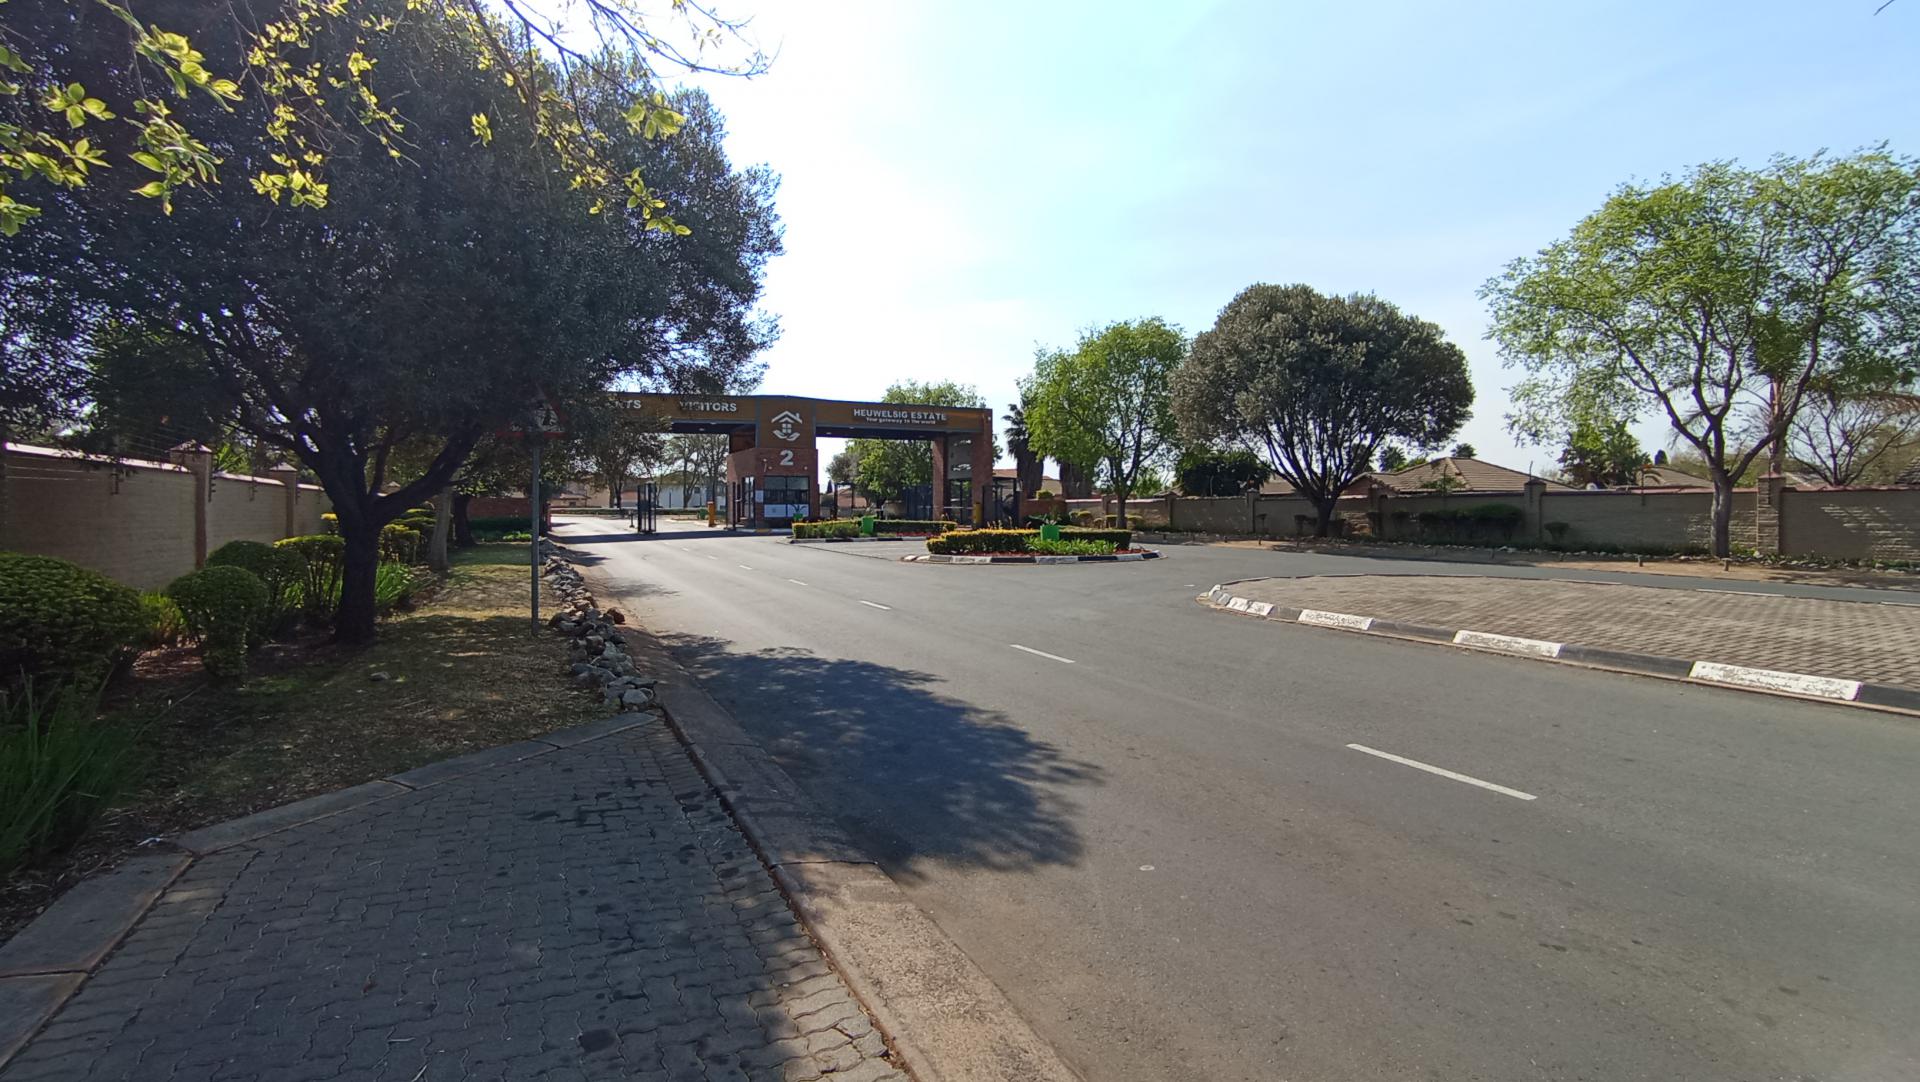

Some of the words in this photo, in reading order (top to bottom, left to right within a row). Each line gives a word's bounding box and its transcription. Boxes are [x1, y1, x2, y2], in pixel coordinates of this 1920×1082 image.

[679, 401, 737, 412] VISITORS
[853, 408, 908, 419] HEUWELSIG
[910, 411, 947, 421] ESTATE
[780, 449, 794, 466] 2
